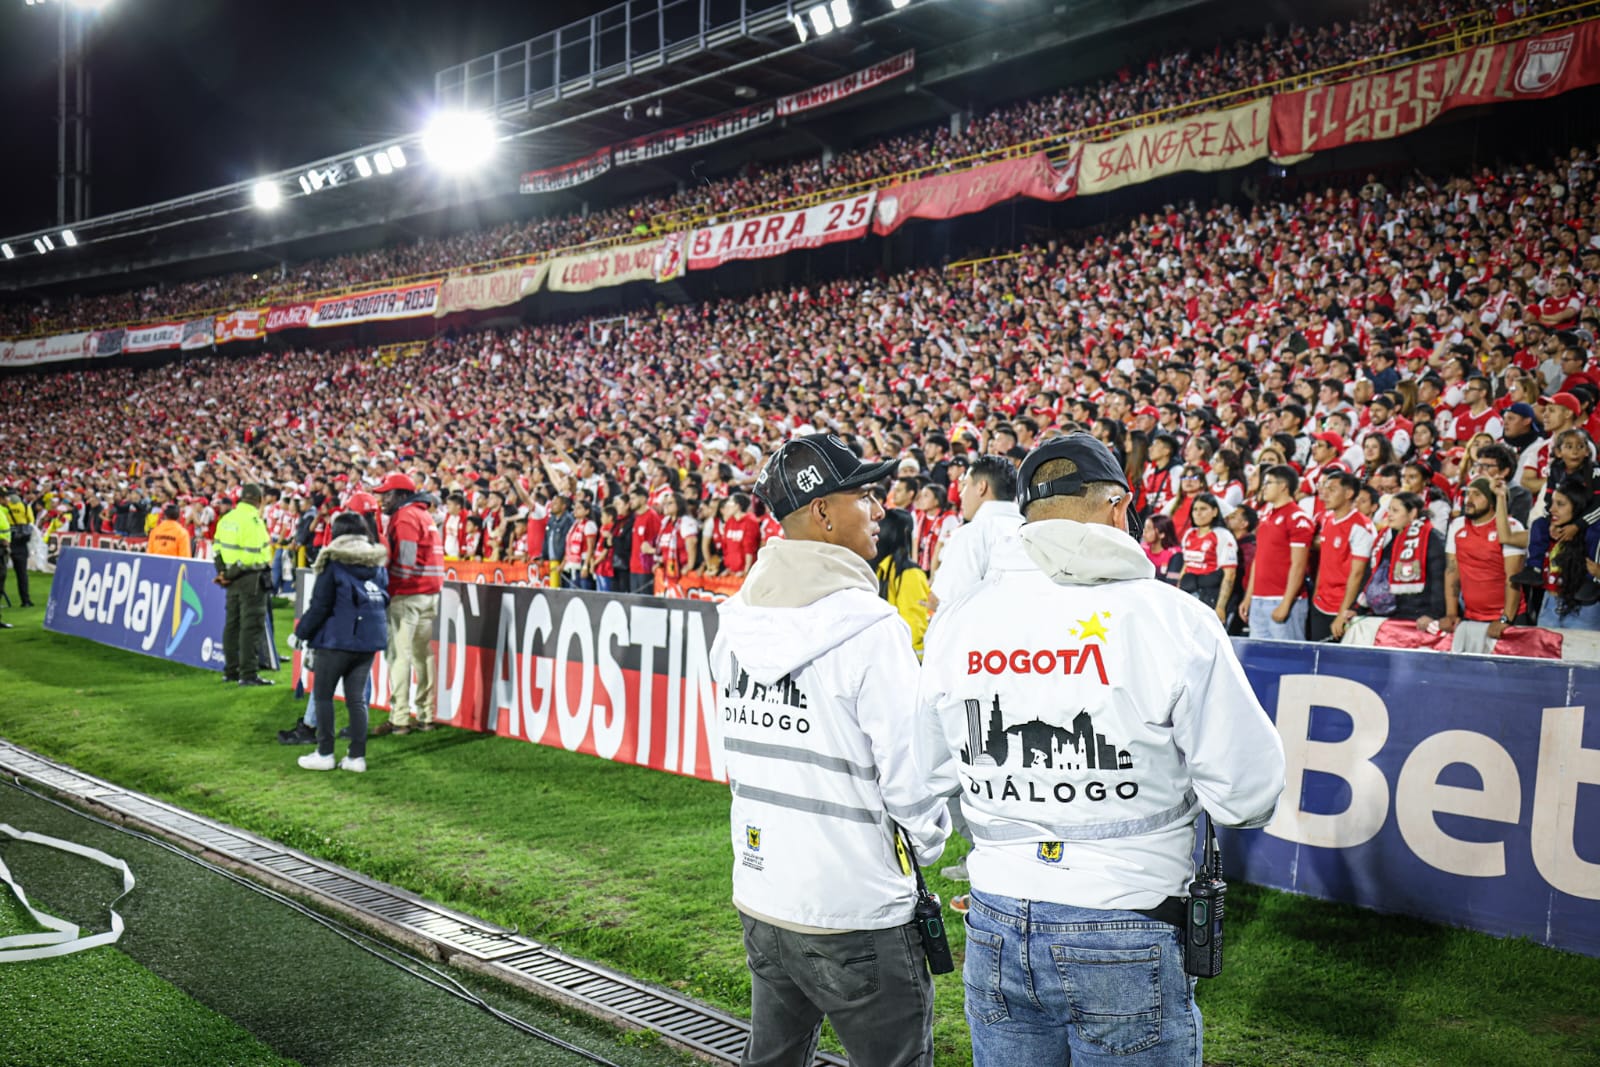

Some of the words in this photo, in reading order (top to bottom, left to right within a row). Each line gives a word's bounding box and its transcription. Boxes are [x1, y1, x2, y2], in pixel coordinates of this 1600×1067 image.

[1302, 86, 1338, 152] EL
[1346, 43, 1515, 120] ARSENAL
[684, 113, 742, 146] SANTA
[1345, 100, 1442, 142] ROJO
[693, 212, 806, 256] BARRA
[824, 197, 870, 232] 25
[318, 301, 345, 321] ROJO
[352, 293, 397, 317] BOGOTA
[402, 287, 436, 311] ROJO
[798, 466, 822, 491] #1
[67, 557, 171, 651] BetPlay
[725, 705, 810, 734] DIÁLOGO
[1264, 674, 1600, 901] Bet
